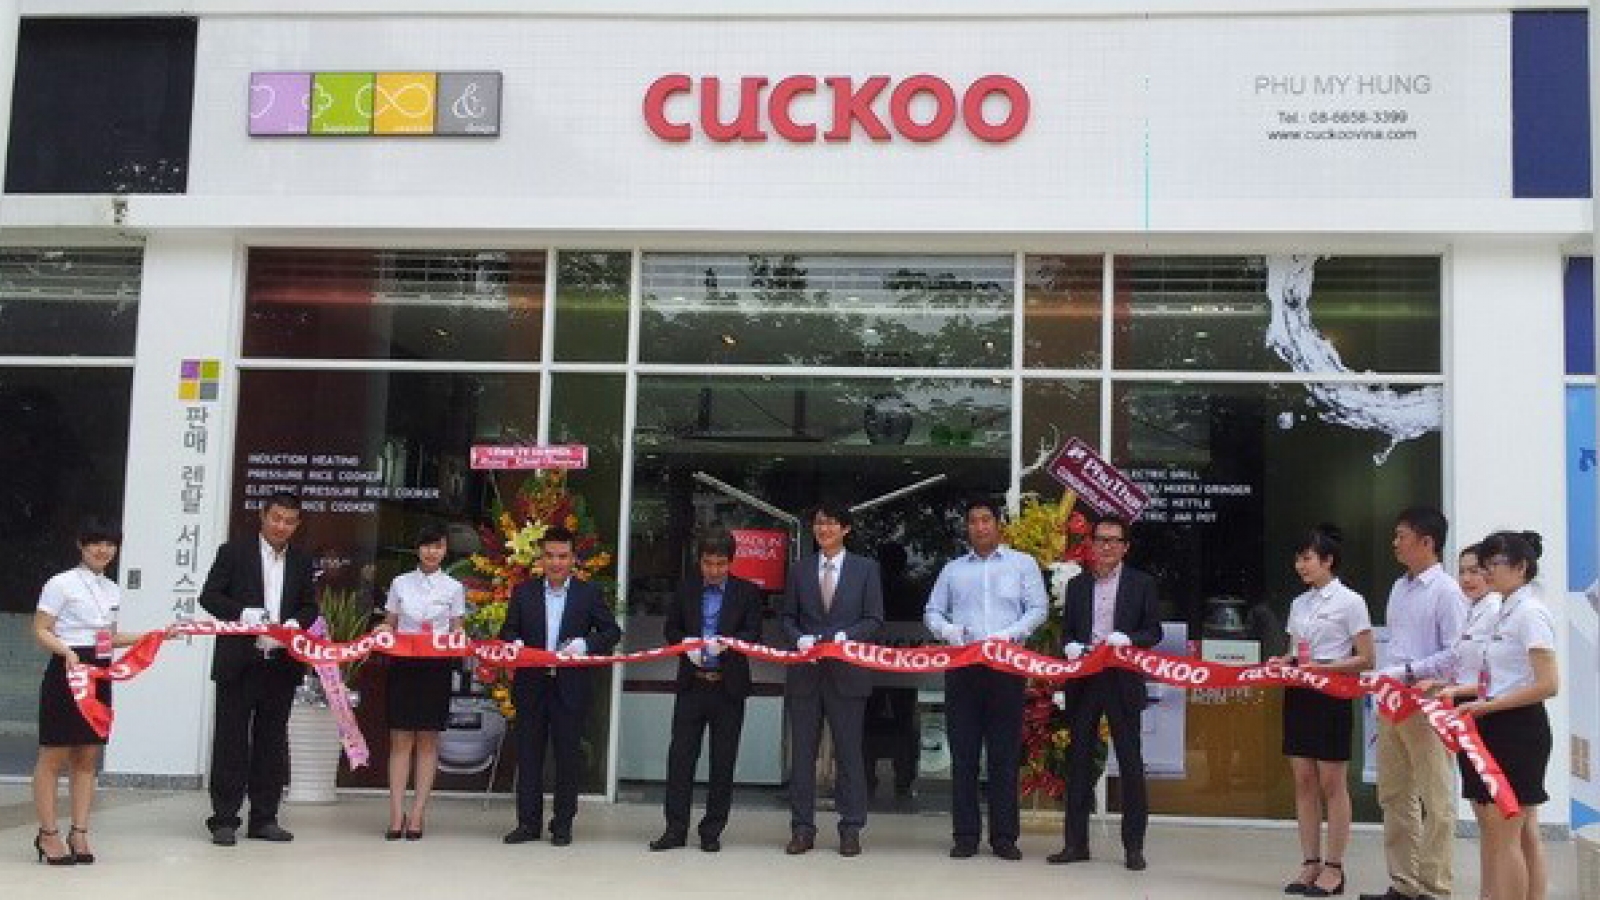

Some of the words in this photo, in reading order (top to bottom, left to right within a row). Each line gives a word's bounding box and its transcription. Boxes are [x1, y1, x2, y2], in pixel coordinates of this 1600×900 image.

[1255, 75, 1306, 95] PHU
[1314, 75, 1350, 95] MY
[1359, 75, 1430, 95] HUNG
[643, 73, 1031, 144] CUCKOO
[309, 471, 333, 480] RICE
[338, 471, 382, 481] COOKER
[365, 487, 389, 498] RICE
[394, 487, 439, 498] COOKER
[301, 501, 326, 511] RICE
[331, 501, 376, 512] COOKER
[291, 631, 395, 660] CUCKOO
[842, 640, 951, 669] CUCKOO
